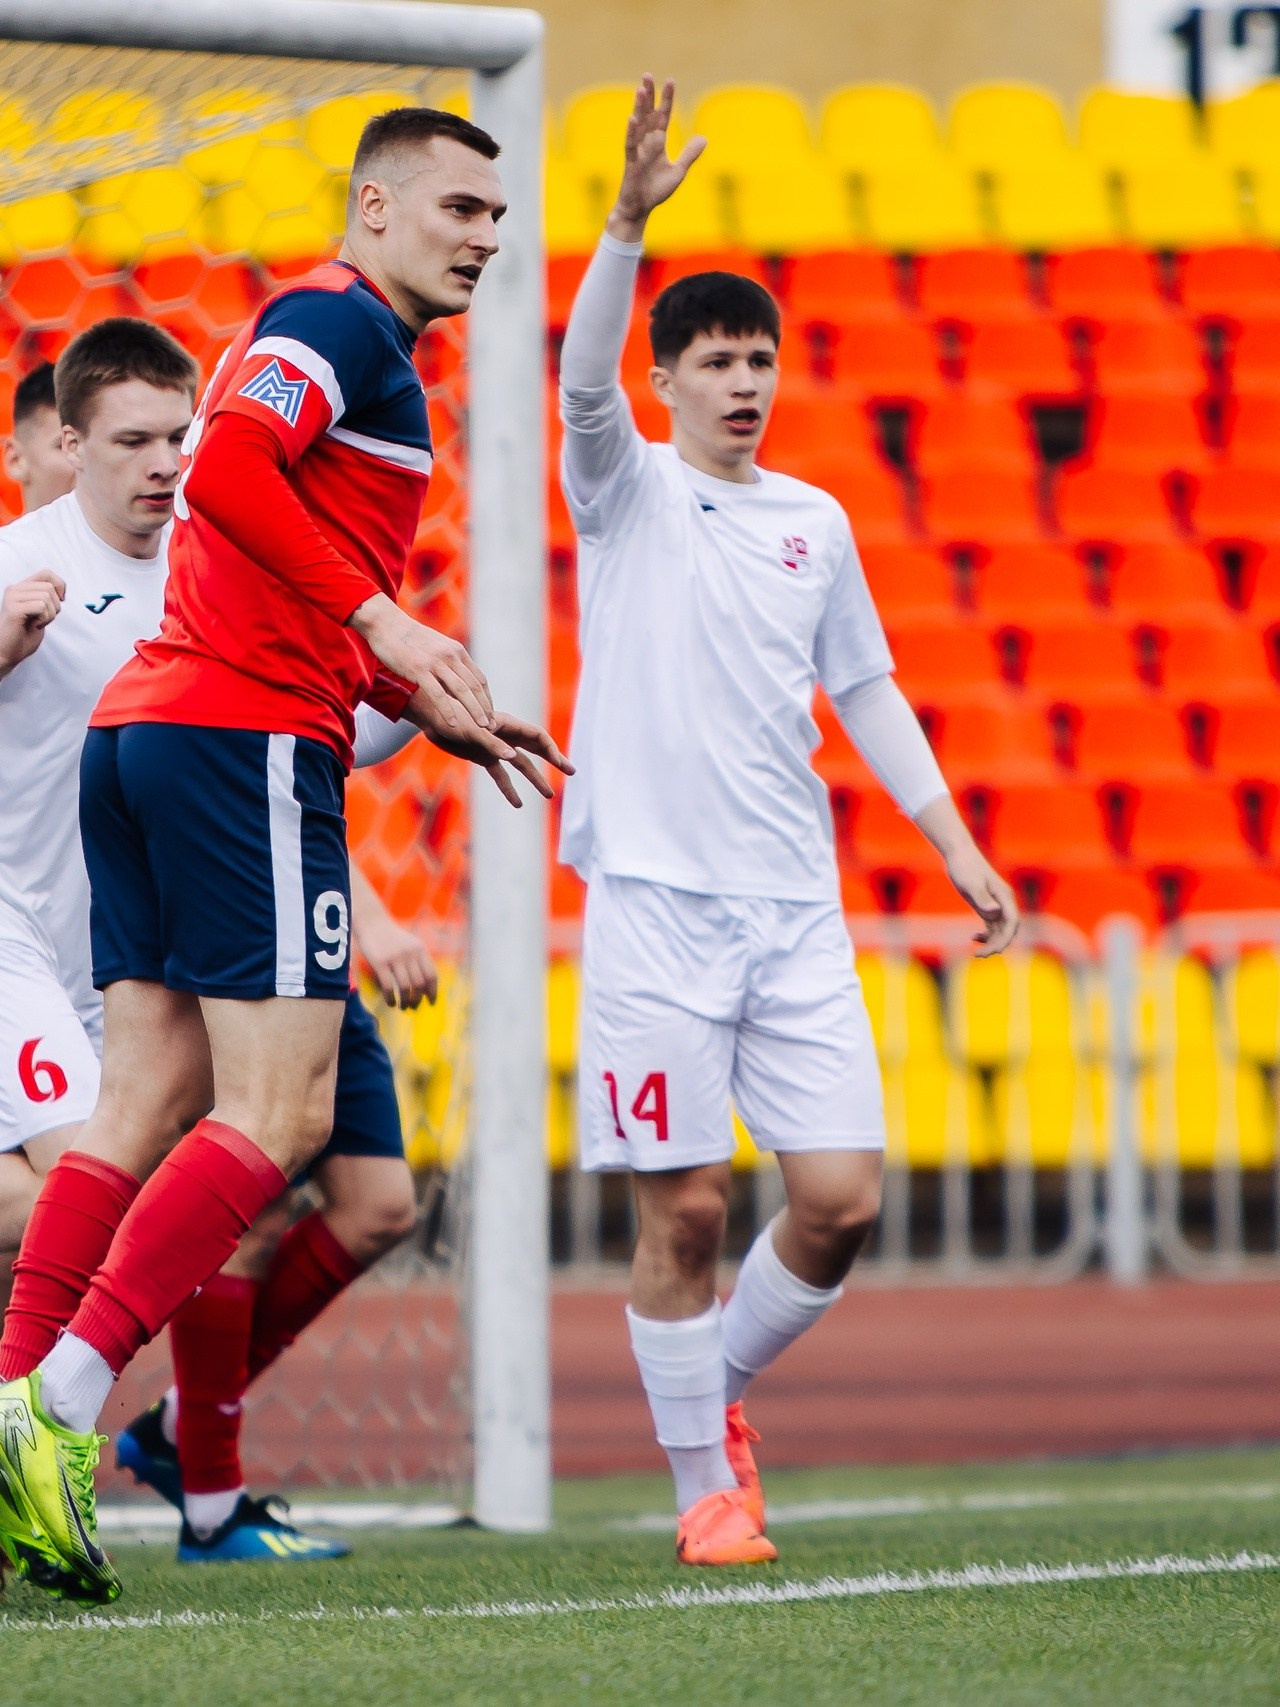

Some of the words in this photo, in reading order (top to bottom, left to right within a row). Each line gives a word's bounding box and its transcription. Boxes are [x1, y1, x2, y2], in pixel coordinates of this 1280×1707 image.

[313, 890, 349, 970] 9
[18, 1036, 68, 1103] 6
[603, 1071, 668, 1141] 14
